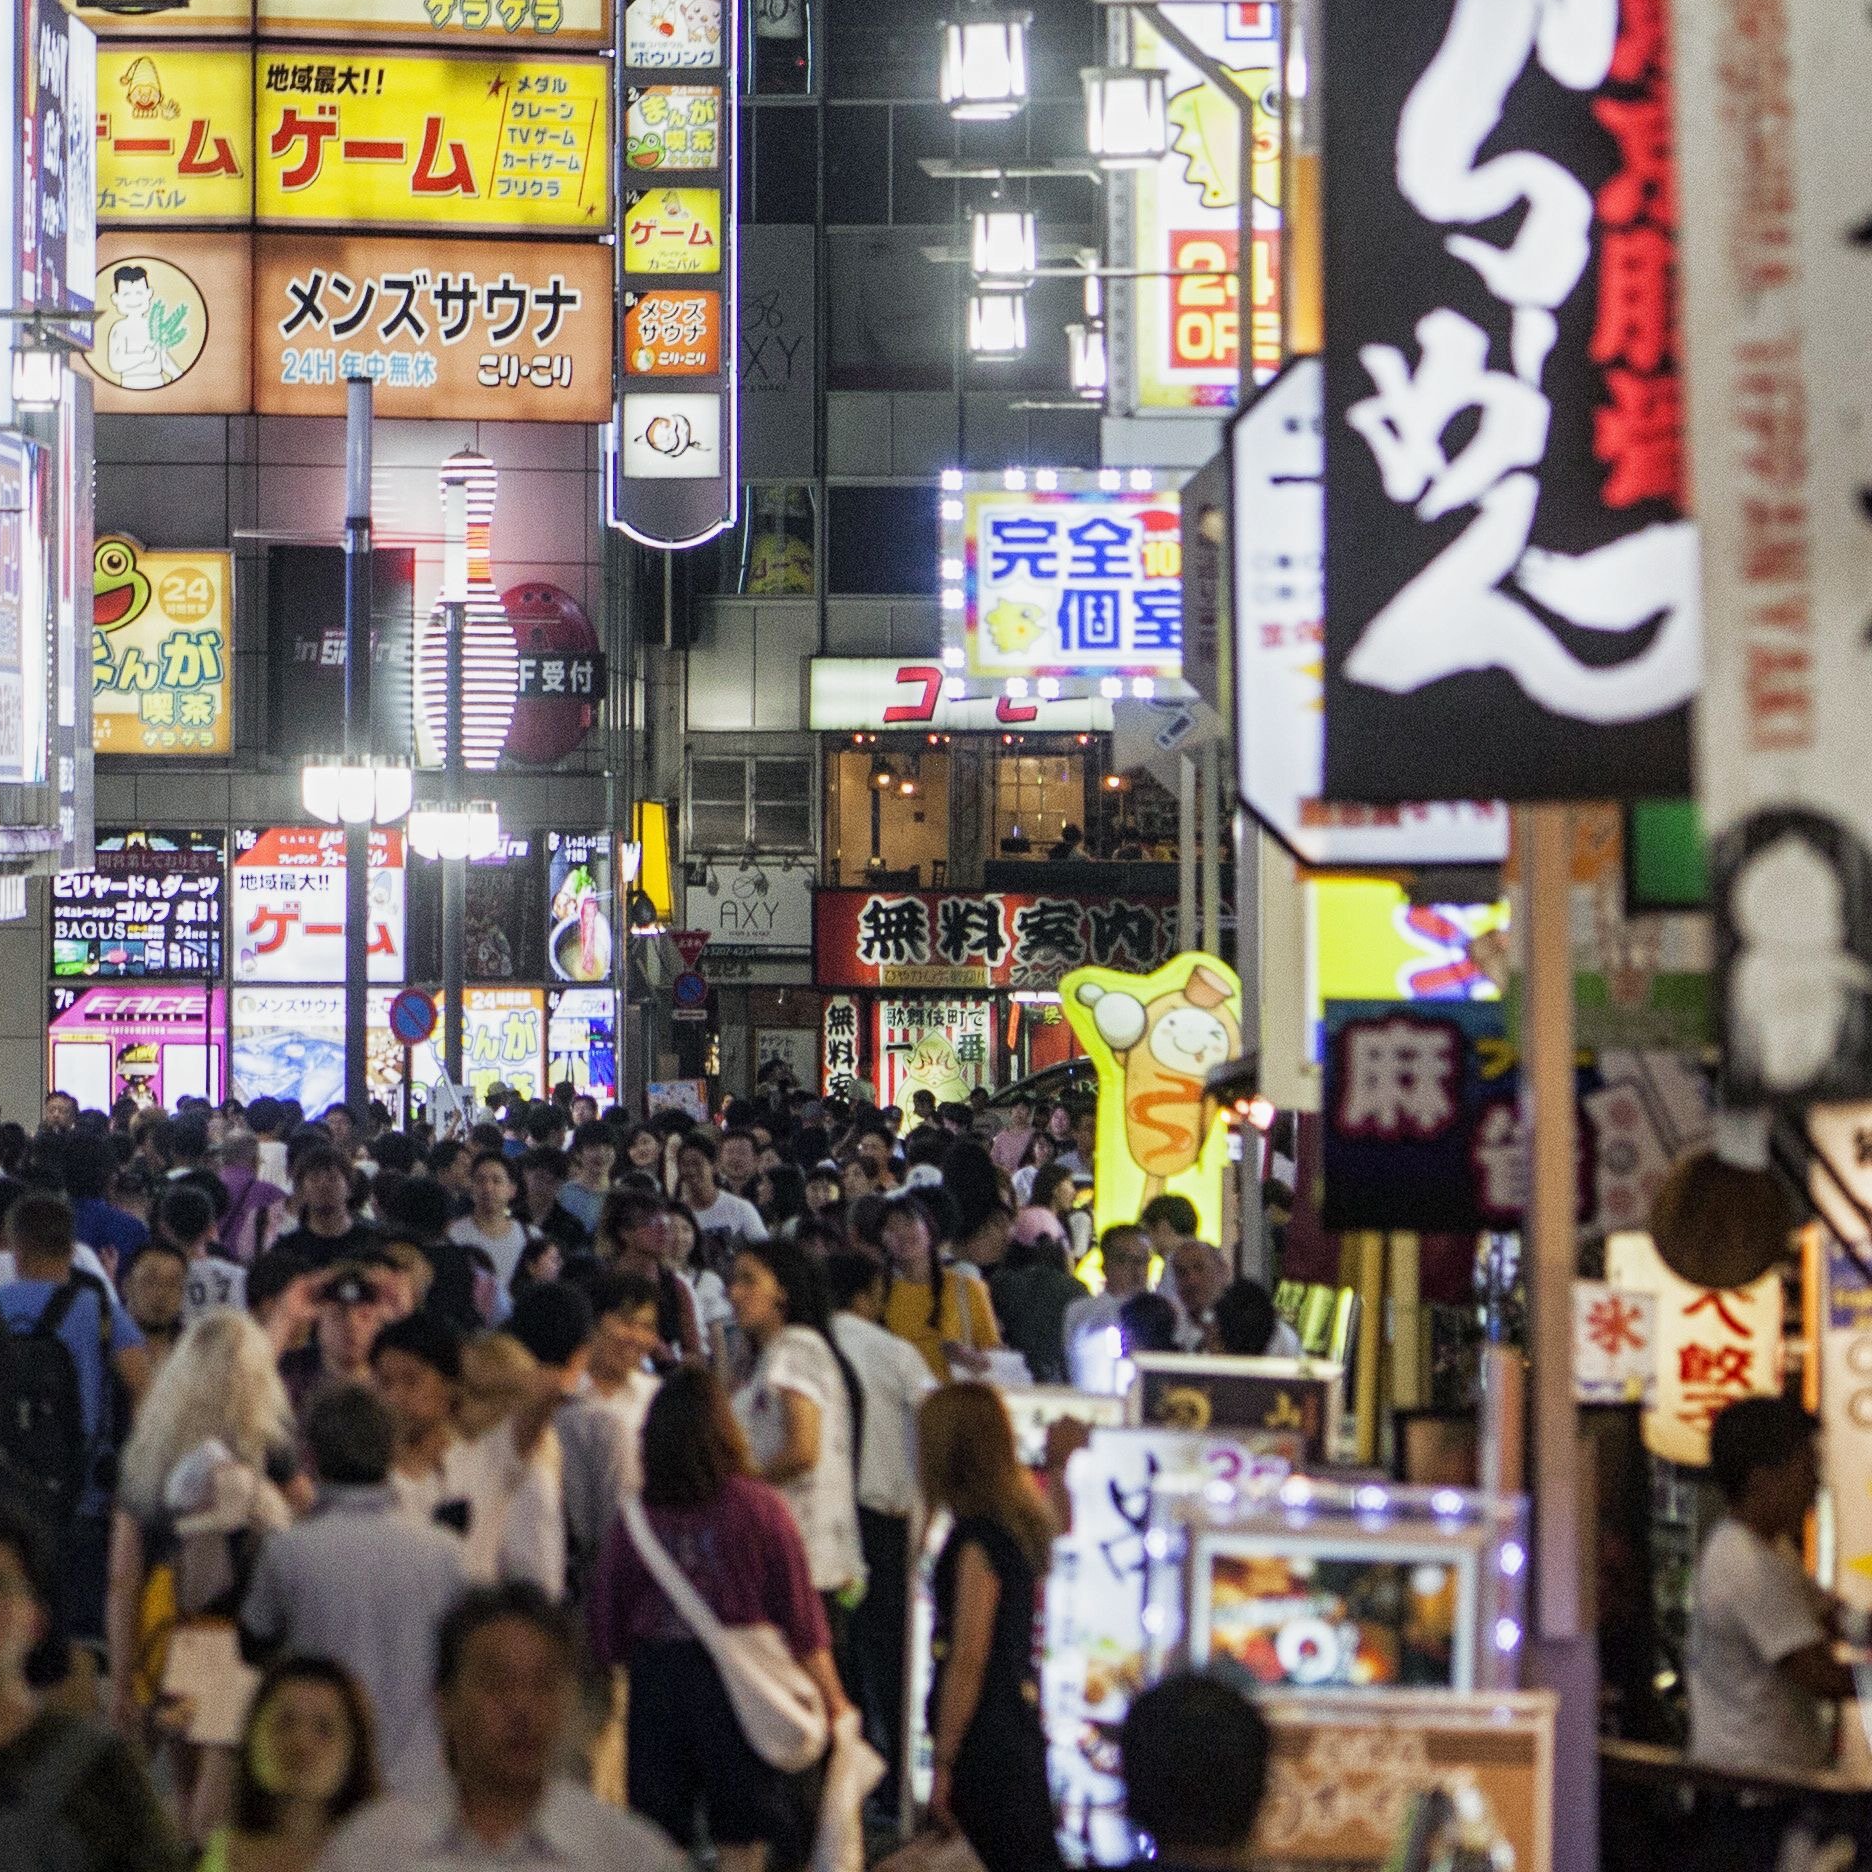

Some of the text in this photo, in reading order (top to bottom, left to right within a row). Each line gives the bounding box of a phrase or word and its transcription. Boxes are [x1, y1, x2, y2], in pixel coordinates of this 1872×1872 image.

[265, 64, 385, 95] 地域最大!!
[517, 76, 567, 94] メダル
[511, 101, 574, 119] クレーン
[270, 104, 480, 199] ゲーム
[502, 152, 580, 171] カードゲーム
[630, 219, 715, 247] ゲーム
[280, 269, 579, 348] メンズサウナ
[639, 298, 707, 322] メンズ
[639, 321, 707, 345] サウナ
[281, 351, 335, 384] 24H
[991, 516, 1136, 582] 完全
[161, 576, 210, 603] 24
[139, 691, 216, 727] 喫茶
[53, 875, 220, 899] ビリヤード&ダーツ
[718, 901, 781, 929] AXY
[54, 921, 127, 940] BAGUS
[83, 995, 210, 1014] FACE
